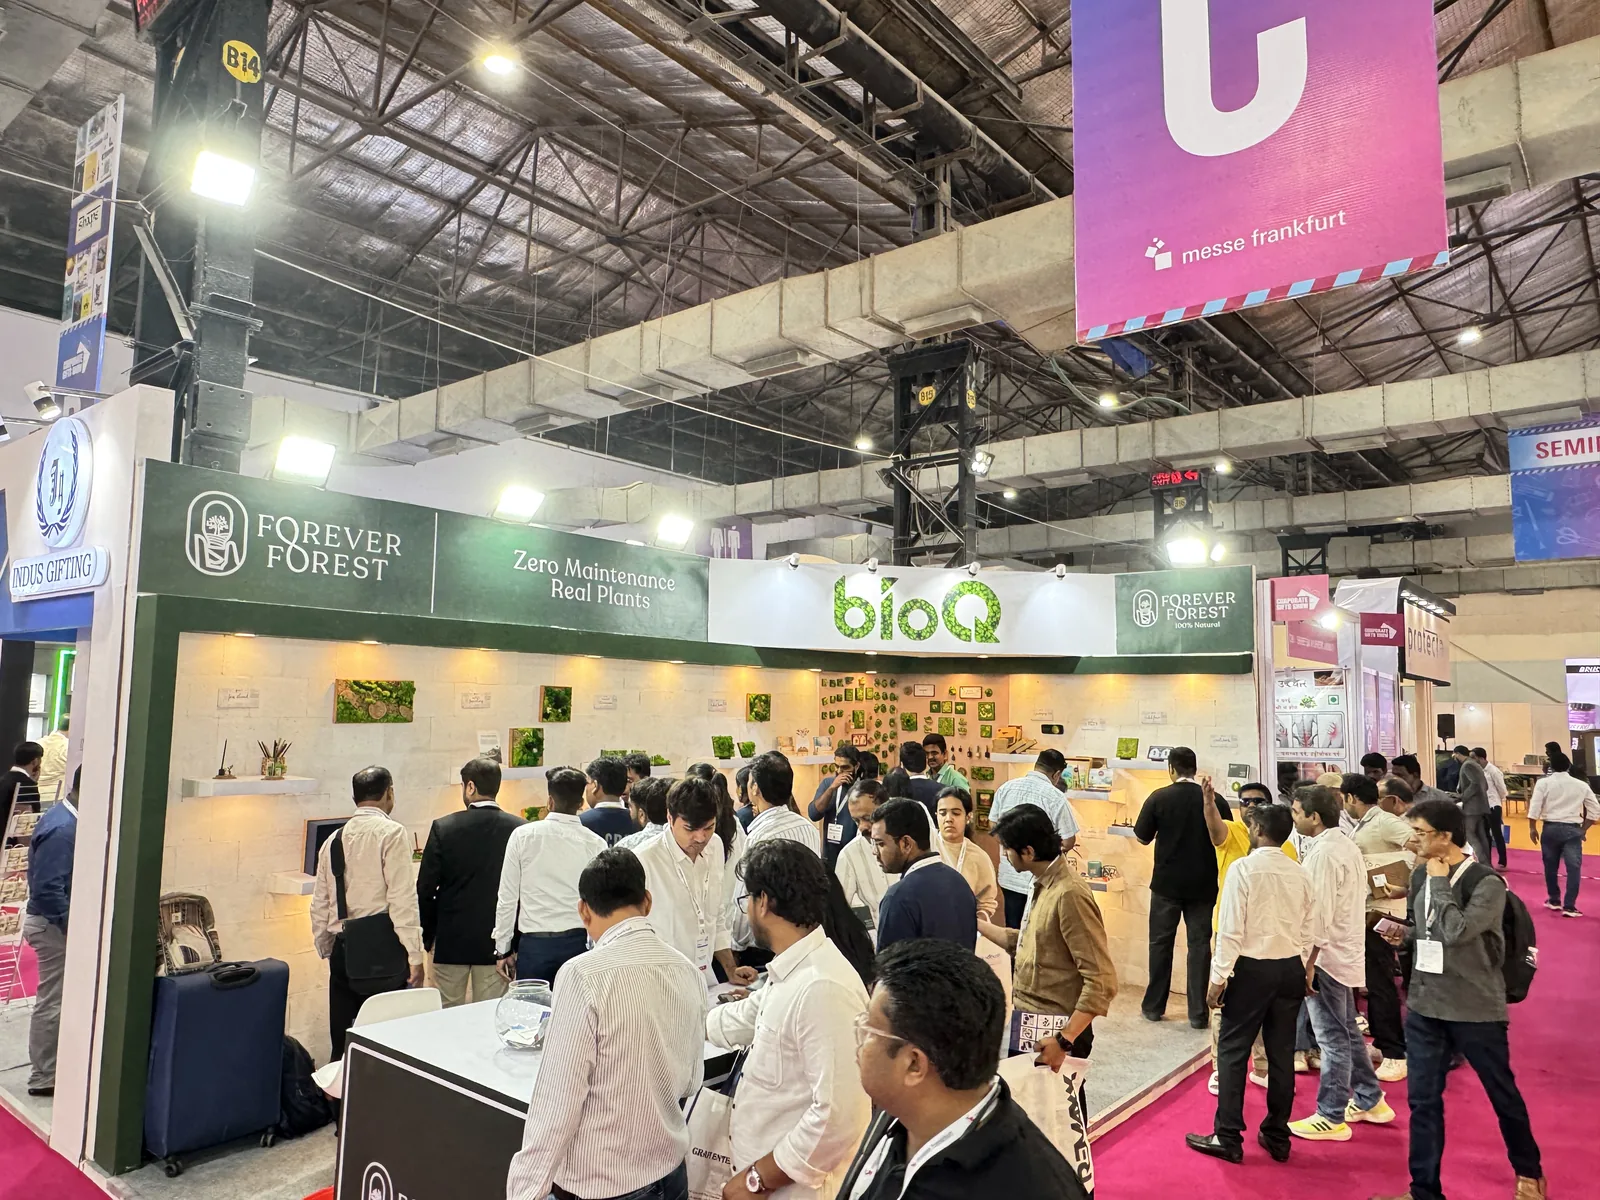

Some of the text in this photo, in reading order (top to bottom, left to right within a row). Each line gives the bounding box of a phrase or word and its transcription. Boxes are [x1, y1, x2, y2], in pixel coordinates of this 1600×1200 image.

[227, 44, 260, 79] B14
[1182, 210, 1347, 264] messe frankfurt
[257, 513, 402, 557] FOREVER
[12, 553, 92, 588] INDUS GIFTING
[267, 543, 389, 581] FOREST
[513, 550, 676, 592] Zero Maintenance
[551, 579, 651, 609] Real Plants
[834, 575, 1002, 643] bioQ
[1161, 591, 1236, 607] FOREVER
[1166, 606, 1229, 621] FOREST
